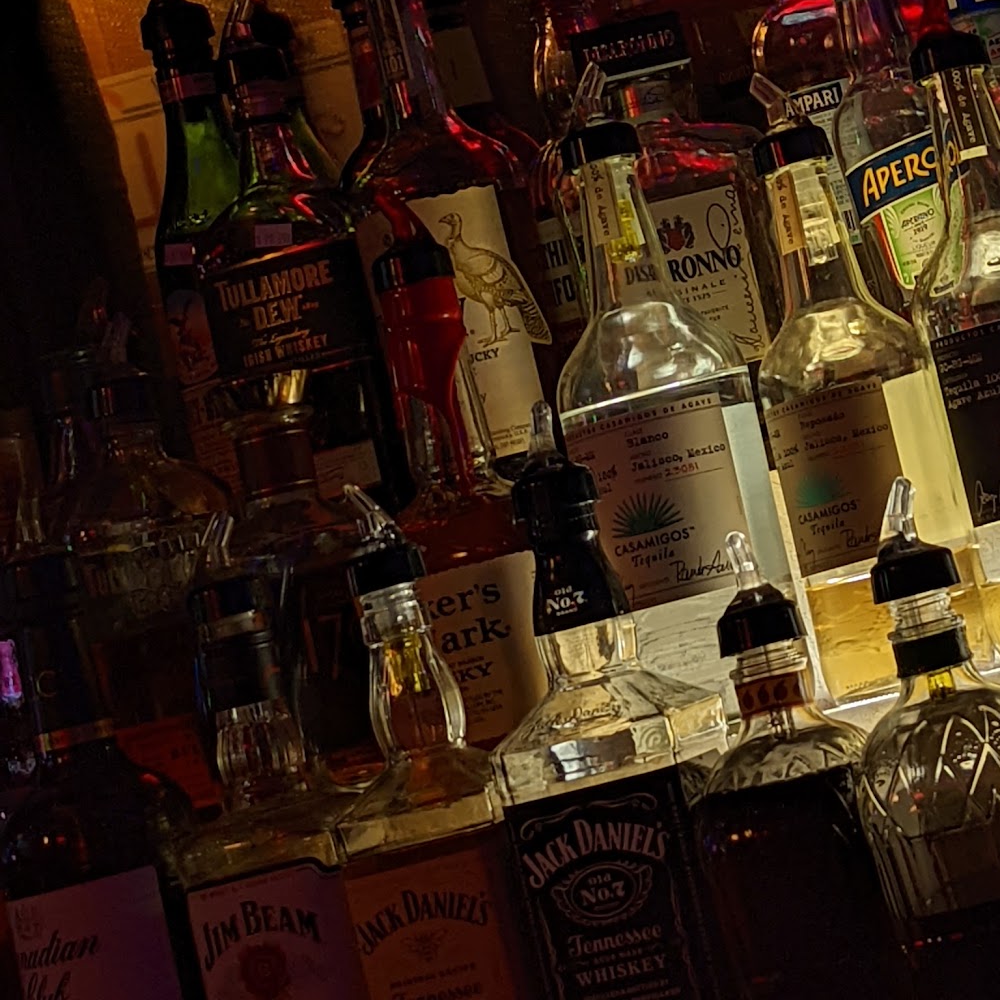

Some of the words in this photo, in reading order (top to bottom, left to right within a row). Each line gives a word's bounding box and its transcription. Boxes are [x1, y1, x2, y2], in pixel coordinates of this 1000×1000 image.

[785, 86, 841, 119] AMPARI
[862, 143, 940, 209] APERO
[213, 258, 337, 313] TULLAMORE
[243, 348, 273, 368] IRISH
[274, 333, 328, 360] WHISKEY
[625, 431, 670, 449] Blanco
[631, 453, 684, 472] Jalisco,
[686, 443, 728, 459] Mexico
[797, 499, 858, 525] CASAMIGOS
[810, 517, 845, 536] Tequila
[615, 527, 690, 557] CASAMIGOS
[631, 547, 676, 568] Tequila
[545, 589, 588, 617] No.7
[441, 617, 512, 654] ark
[521, 832, 580, 889] JACK
[572, 818, 672, 863] DANIEL'S
[578, 881, 633, 907] No.7
[202, 913, 240, 973] JIM
[239, 900, 322, 945] BEAM
[354, 903, 406, 956] JACK
[400, 888, 490, 926] DANIEL'S
[567, 923, 663, 958] Tennessee
[575, 952, 667, 988] WHISKEY
